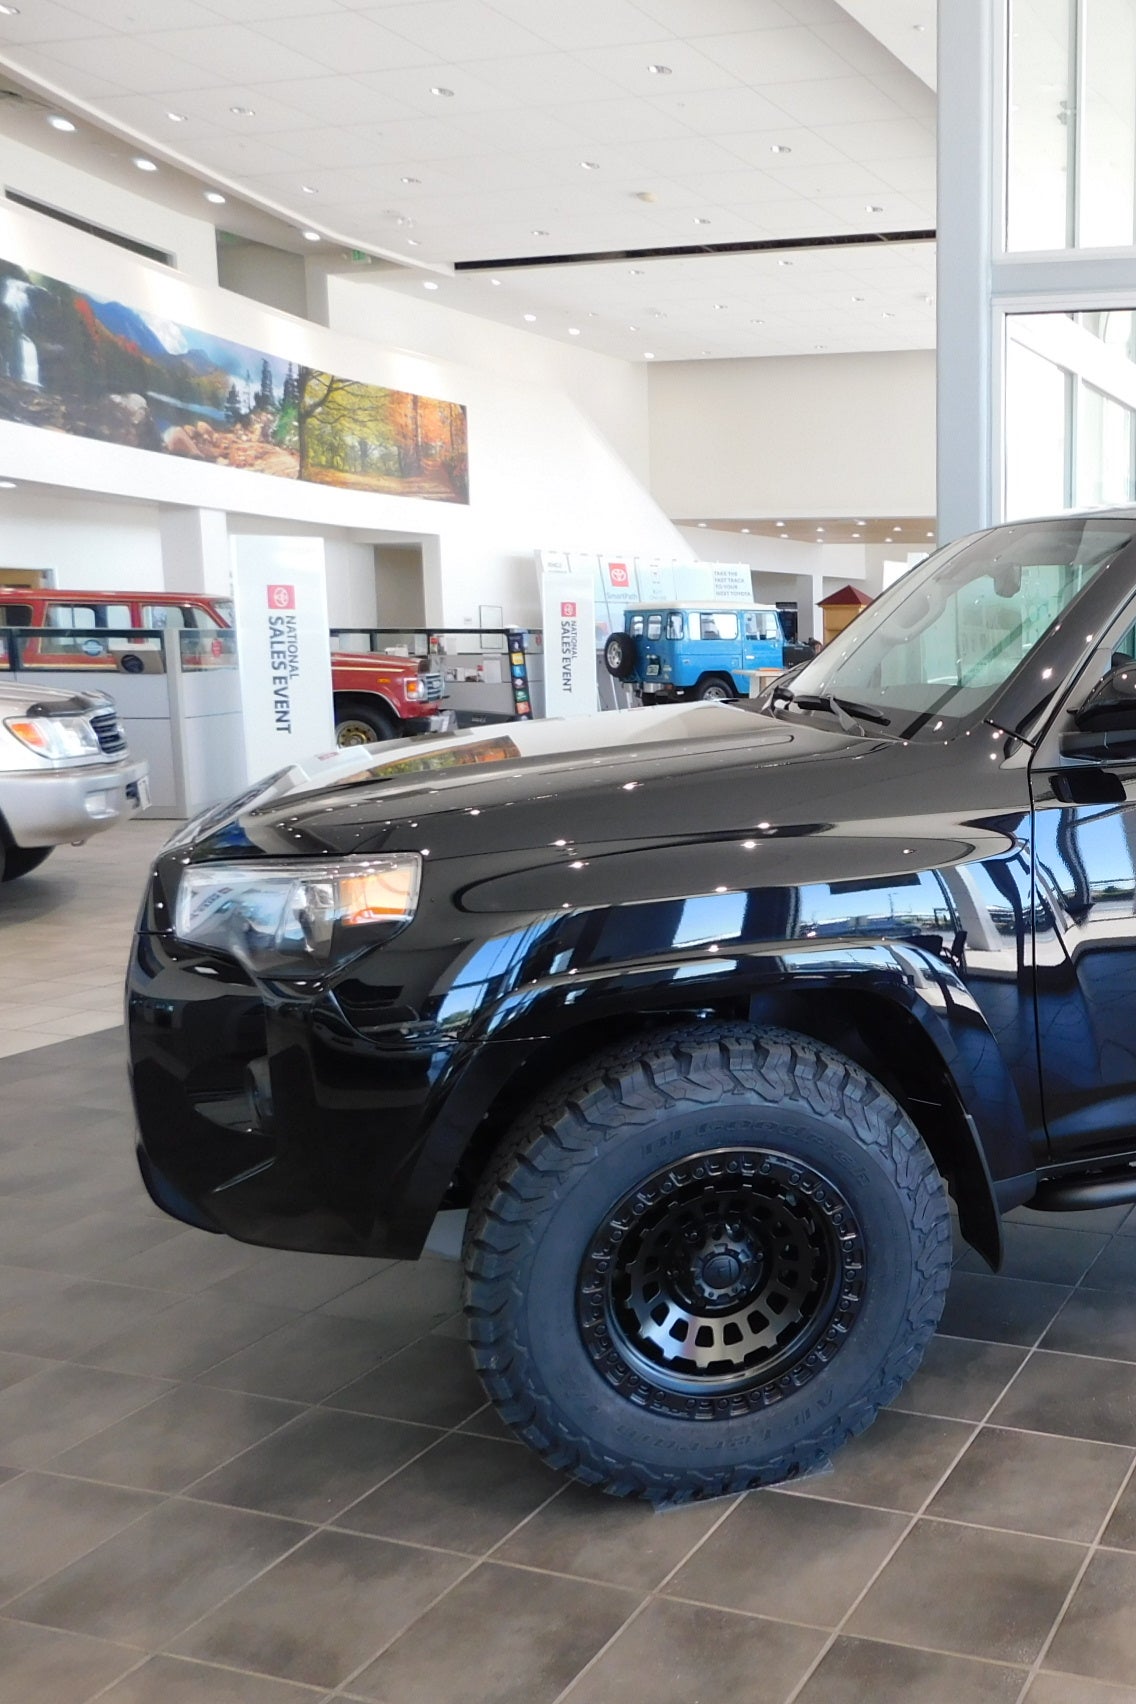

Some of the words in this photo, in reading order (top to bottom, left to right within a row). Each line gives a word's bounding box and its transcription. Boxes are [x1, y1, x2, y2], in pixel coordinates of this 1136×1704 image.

[268, 615, 288, 671] SALES
[285, 615, 300, 680] NATIONAL
[561, 620, 571, 655] SALES
[570, 620, 578, 659] NATIONAL
[562, 657, 572, 693] EVENT
[272, 675, 292, 734] EVENT
